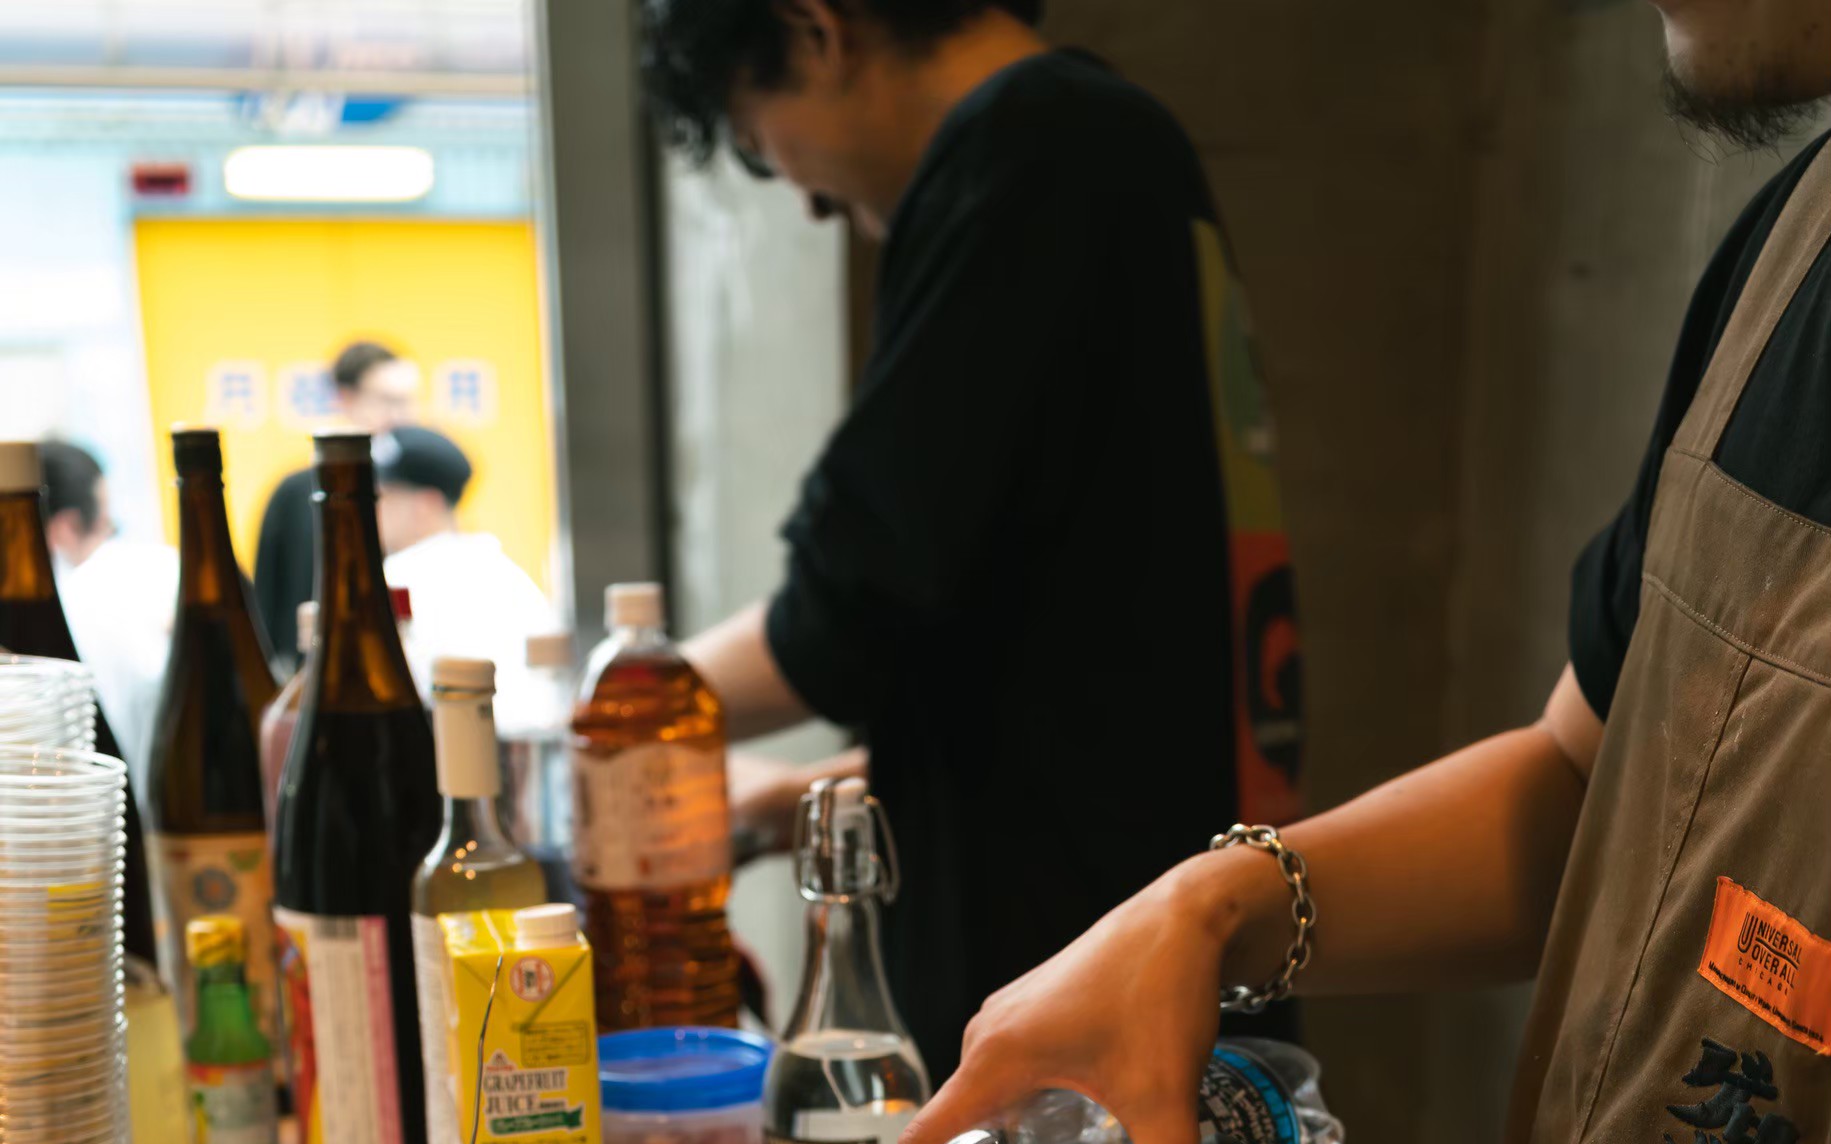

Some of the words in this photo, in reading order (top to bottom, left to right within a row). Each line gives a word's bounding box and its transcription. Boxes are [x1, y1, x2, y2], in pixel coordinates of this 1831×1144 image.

[1738, 912, 1802, 964] UNIVERSAL
[1751, 944, 1795, 989] OVERALL
[484, 1069, 565, 1093] GRAPEFRUIT
[486, 1093, 537, 1115] JUICE
